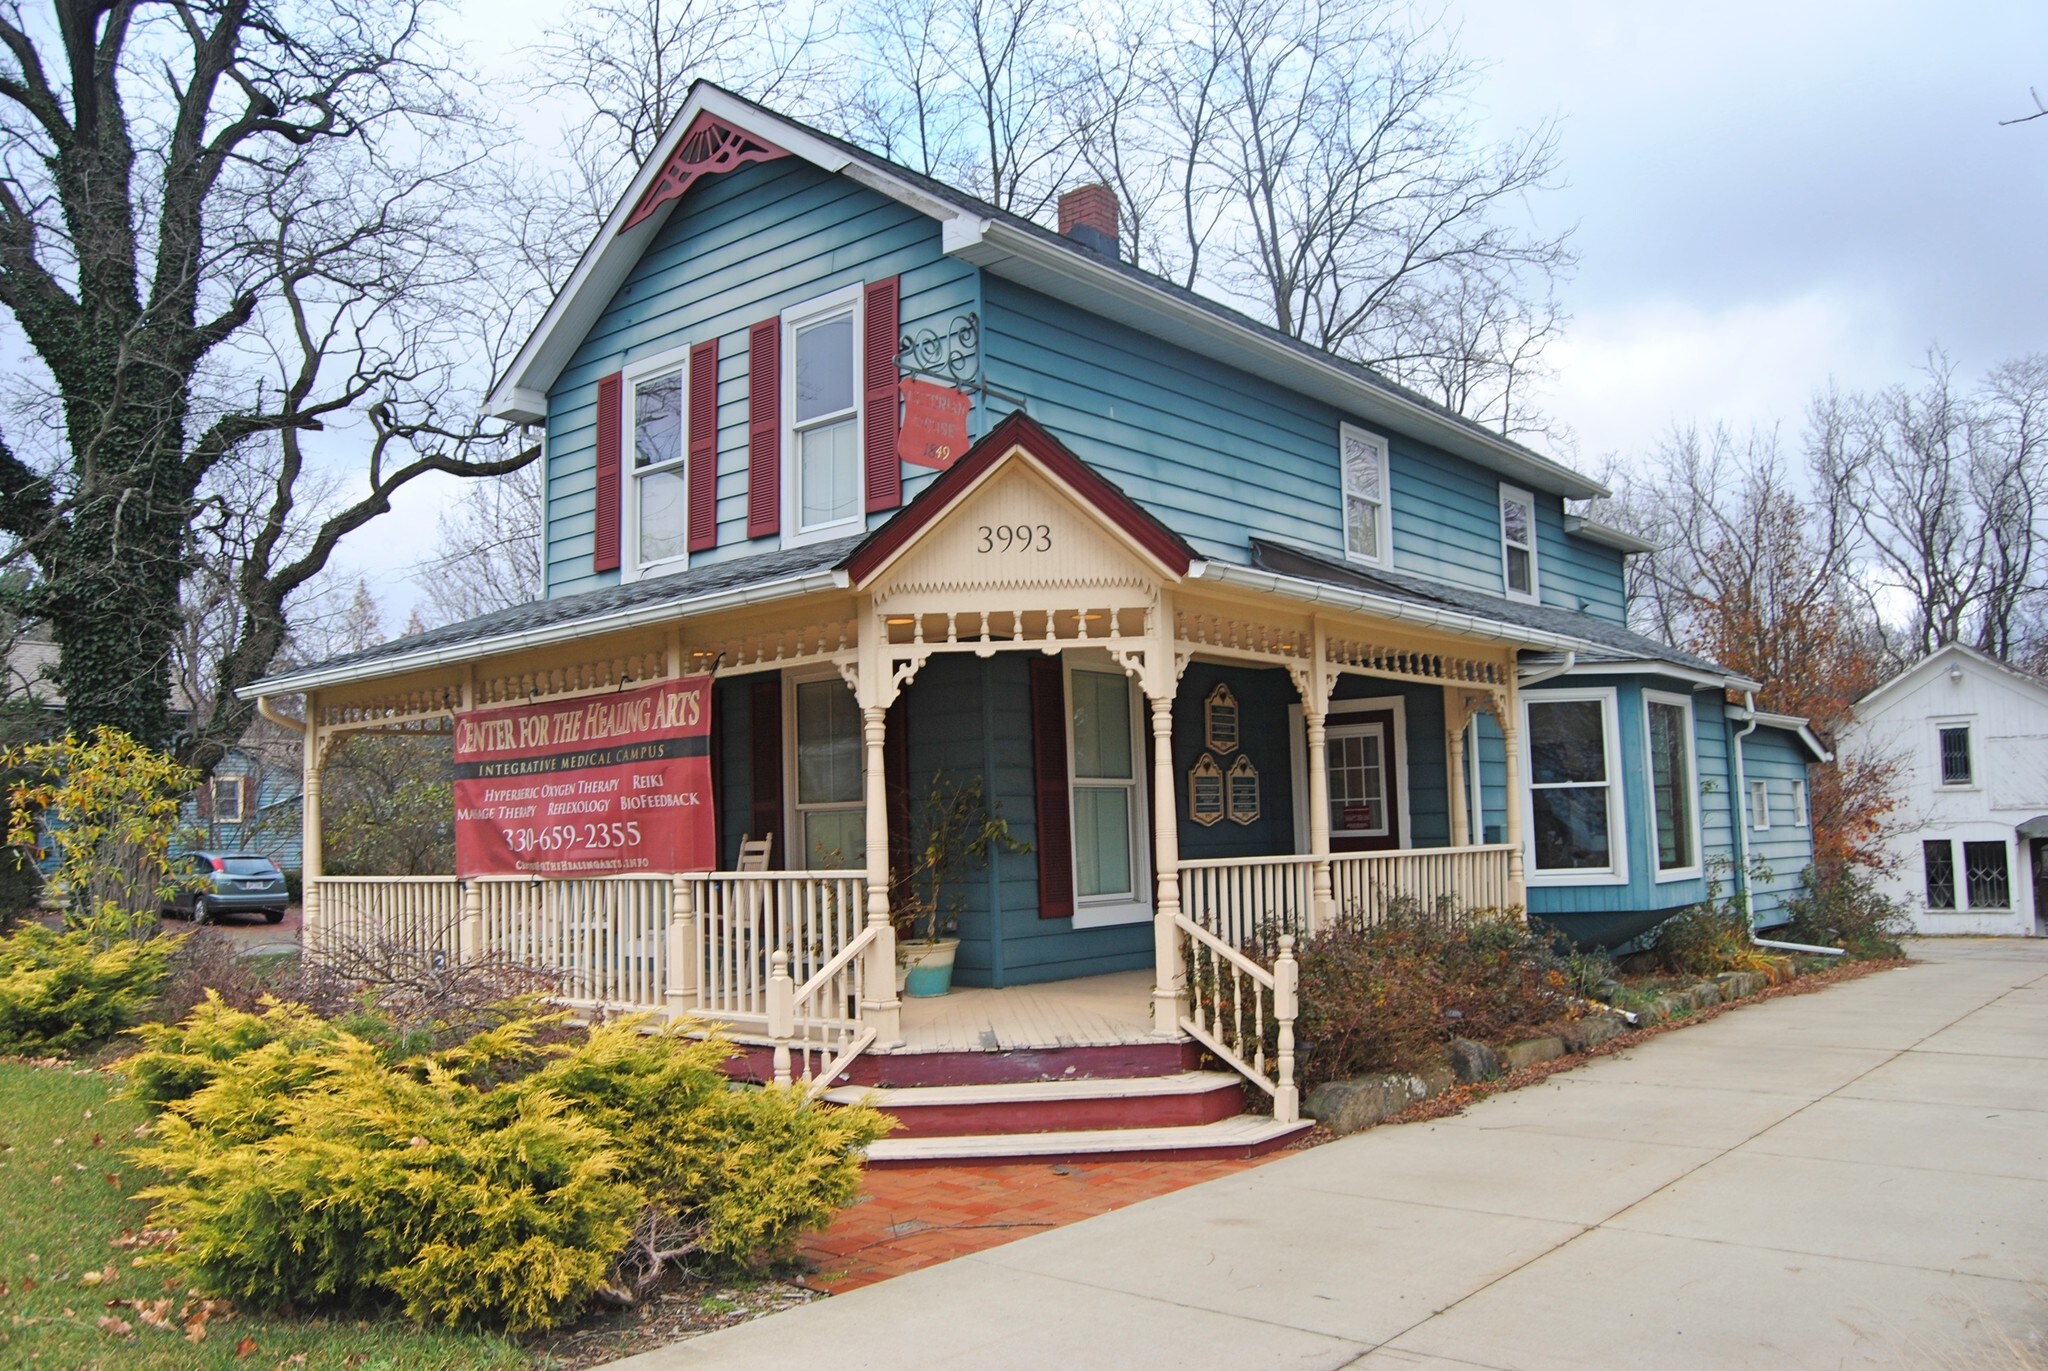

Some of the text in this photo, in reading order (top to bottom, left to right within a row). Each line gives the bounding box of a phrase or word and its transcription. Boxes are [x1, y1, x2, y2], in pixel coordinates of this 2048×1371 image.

[977, 525, 1052, 553] 3993
[456, 688, 700, 754] CENTER FOR THE HEALING ARTS
[478, 743, 665, 777] INTEGRATIVE MEDICAL CAMPUS
[541, 782, 577, 798] OXYGEN
[577, 778, 620, 794] THERAPY
[633, 774, 664, 790] REIKI
[547, 798, 611, 816] REFLEXOLOGY
[620, 791, 701, 811] BIOFEEDBACK
[502, 820, 642, 852] 330-659-2355
